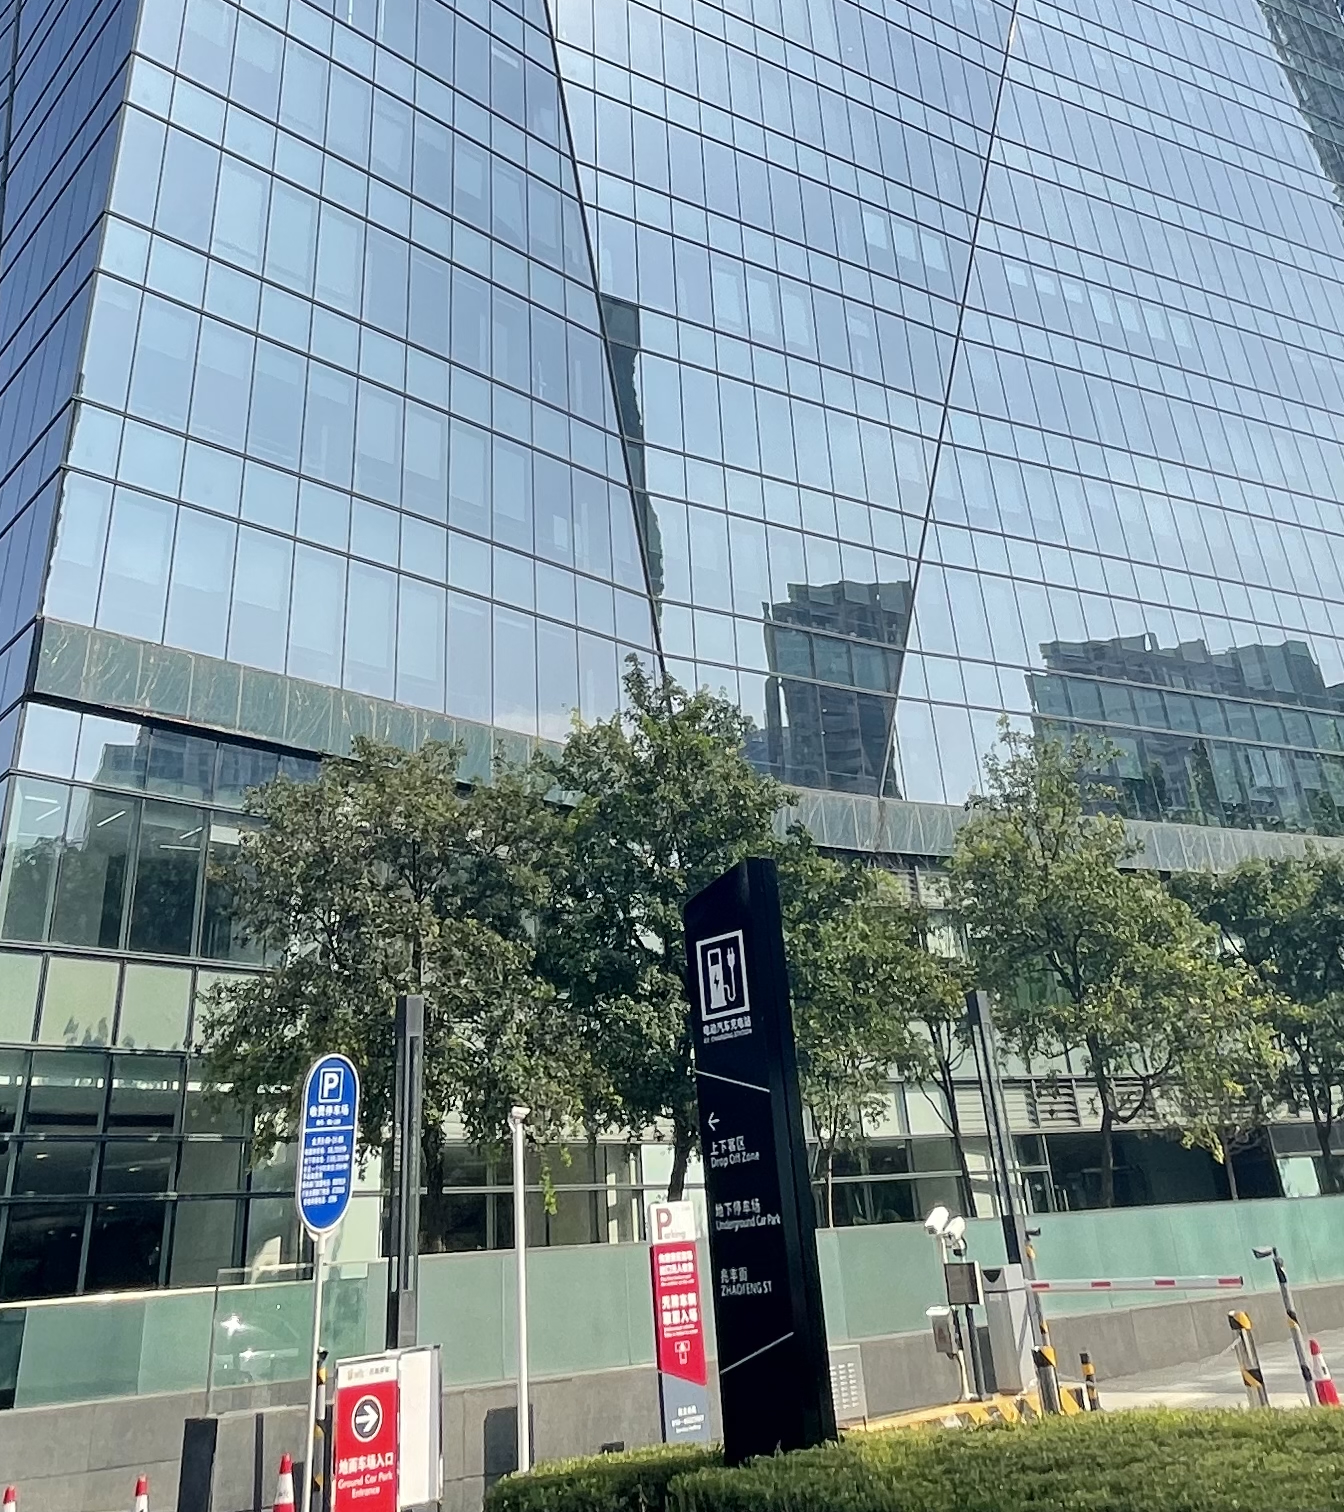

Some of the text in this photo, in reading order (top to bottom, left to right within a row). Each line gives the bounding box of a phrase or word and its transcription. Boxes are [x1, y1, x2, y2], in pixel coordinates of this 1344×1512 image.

[323, 1072, 339, 1098] P
[710, 1151, 760, 1168] Drop Off Zone
[756, 1214, 766, 1226] Car
[767, 1213, 781, 1226] Park
[763, 1280, 772, 1294] ST
[338, 1451, 394, 1475] 地面车场入口
[337, 1470, 394, 1490] Ground Car Park
[351, 1486, 381, 1499] Entrance
